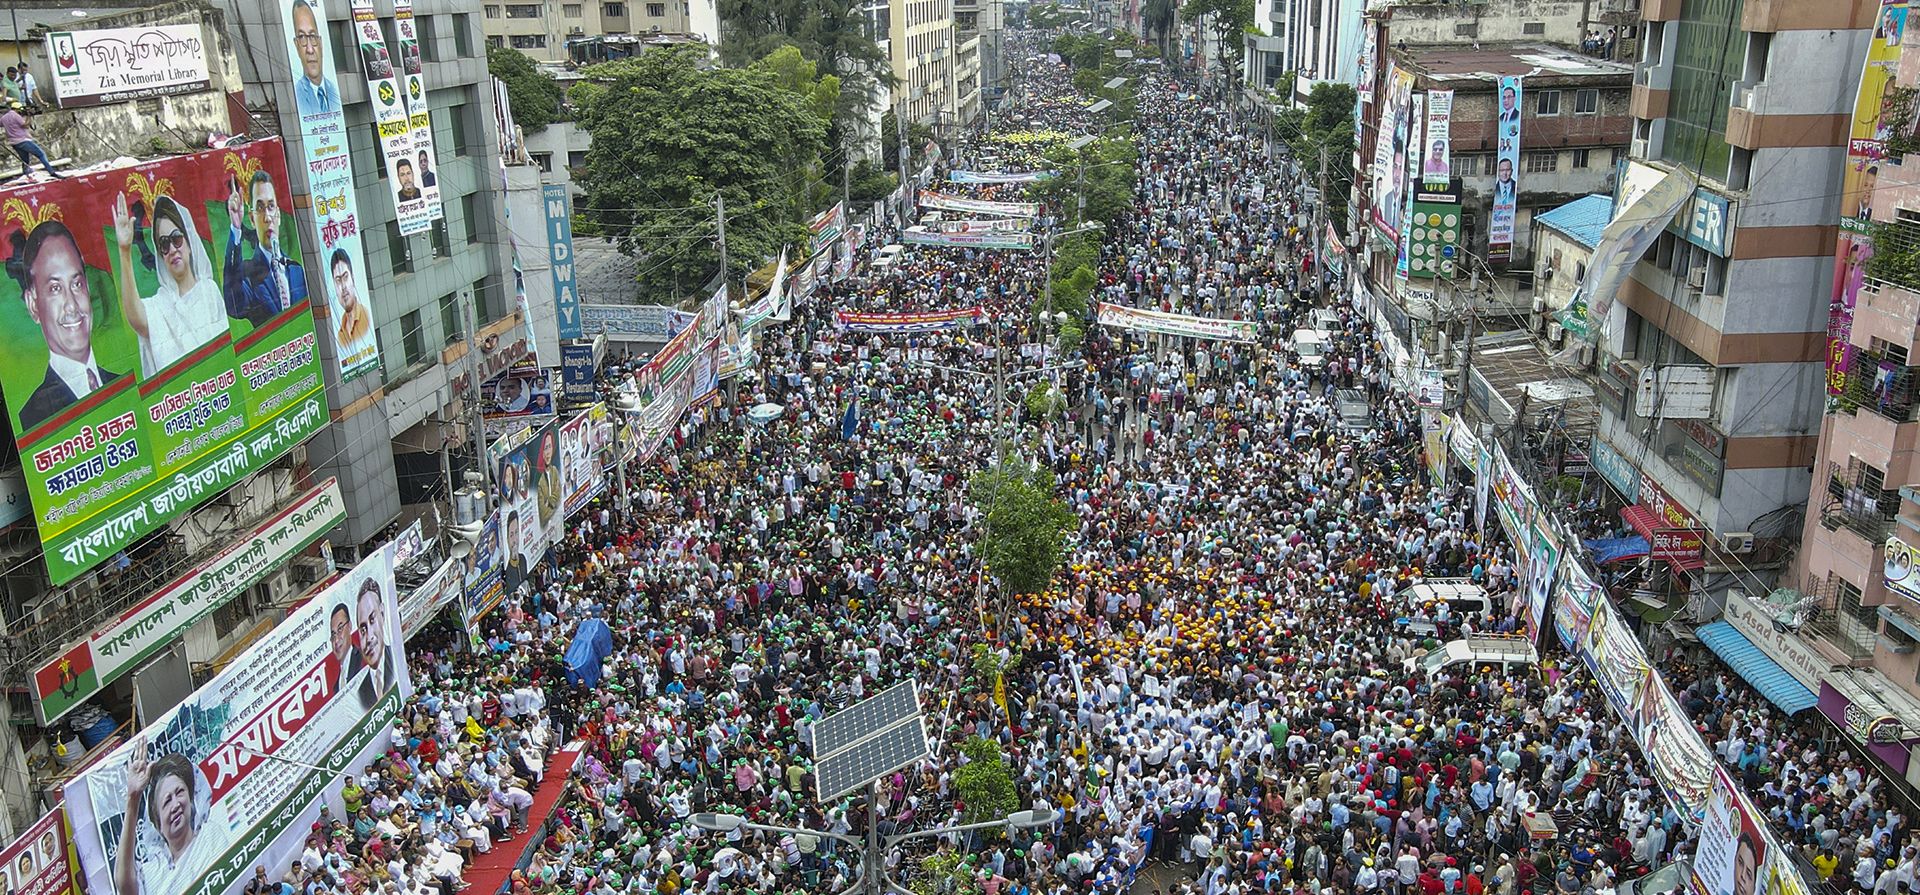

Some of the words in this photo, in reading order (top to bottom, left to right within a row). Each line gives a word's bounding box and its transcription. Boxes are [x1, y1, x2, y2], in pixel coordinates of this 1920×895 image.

[78, 38, 125, 72] জিয়া
[124, 32, 164, 70] স্মৃতি
[99, 75, 117, 88] Zia
[120, 70, 166, 86] Memorial
[168, 67, 198, 80] Library
[544, 188, 565, 197] HOTEL
[321, 218, 339, 248] মুক্তি
[339, 214, 356, 238] চাই
[548, 200, 574, 324] MIDWAY
[241, 355, 272, 377] বাংলাদেশ
[272, 345, 288, 364] যাবে
[277, 362, 289, 377] হবে
[289, 347, 314, 372] রাজপথে
[149, 389, 192, 423] ফ্যাসিবাদ
[191, 380, 218, 405] নিপাত
[218, 369, 236, 389] যাক
[565, 382, 593, 394] Restaurant
[164, 411, 193, 437] গণতন্ত্র
[193, 400, 212, 427] মুক্তি
[212, 393, 231, 414] পাক
[33, 426, 96, 472] জনগণই
[97, 411, 137, 442] সকল
[46, 454, 104, 495] ক্ষমতার
[105, 439, 138, 468] উৎস
[60, 500, 150, 567] বাংলাদেশ
[150, 441, 249, 515] জাতীয়তাবাদী
[249, 399, 321, 460] দল-বিএনপি
[98, 599, 176, 658] বাংলাদেশ
[177, 538, 266, 606] জাতীয়তাবাদী
[267, 494, 334, 548] দল-বিএনপি
[205, 579, 236, 604] কেন্দ্রীয়
[237, 557, 269, 581] কার্যালয়
[1742, 610, 1772, 641] Asad
[1775, 634, 1823, 687] Trading
[208, 661, 329, 790] সমাবেশ
[271, 770, 322, 827] মহানগর
[327, 694, 399, 777] (উত্তর-দক্ষিণ)
